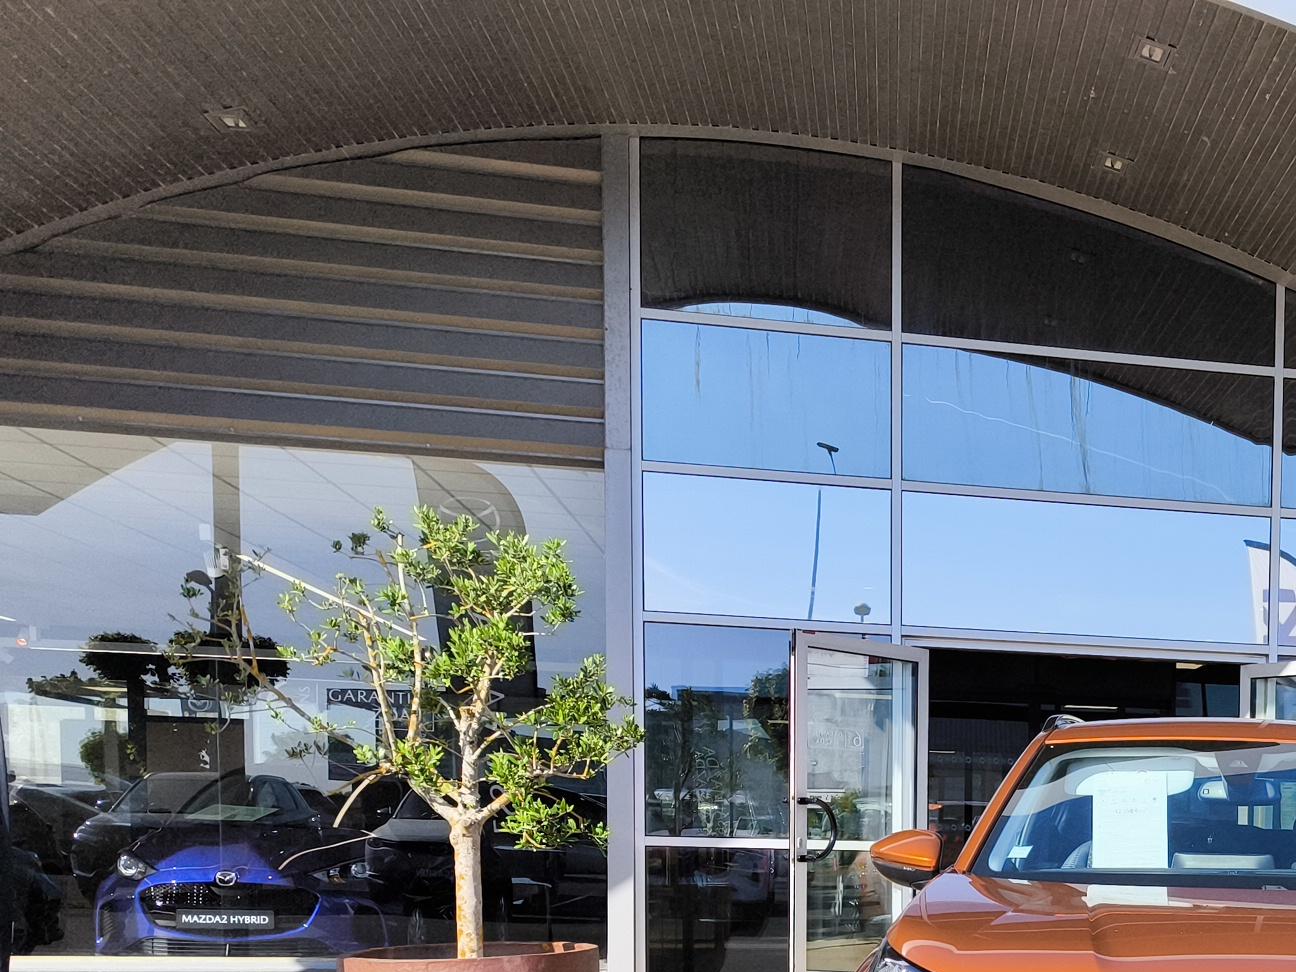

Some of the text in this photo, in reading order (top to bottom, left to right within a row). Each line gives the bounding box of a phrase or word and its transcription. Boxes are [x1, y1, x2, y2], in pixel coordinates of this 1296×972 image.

[328, 689, 413, 704] GARANTI
[181, 914, 269, 924] MAZDA2 HYBRID
